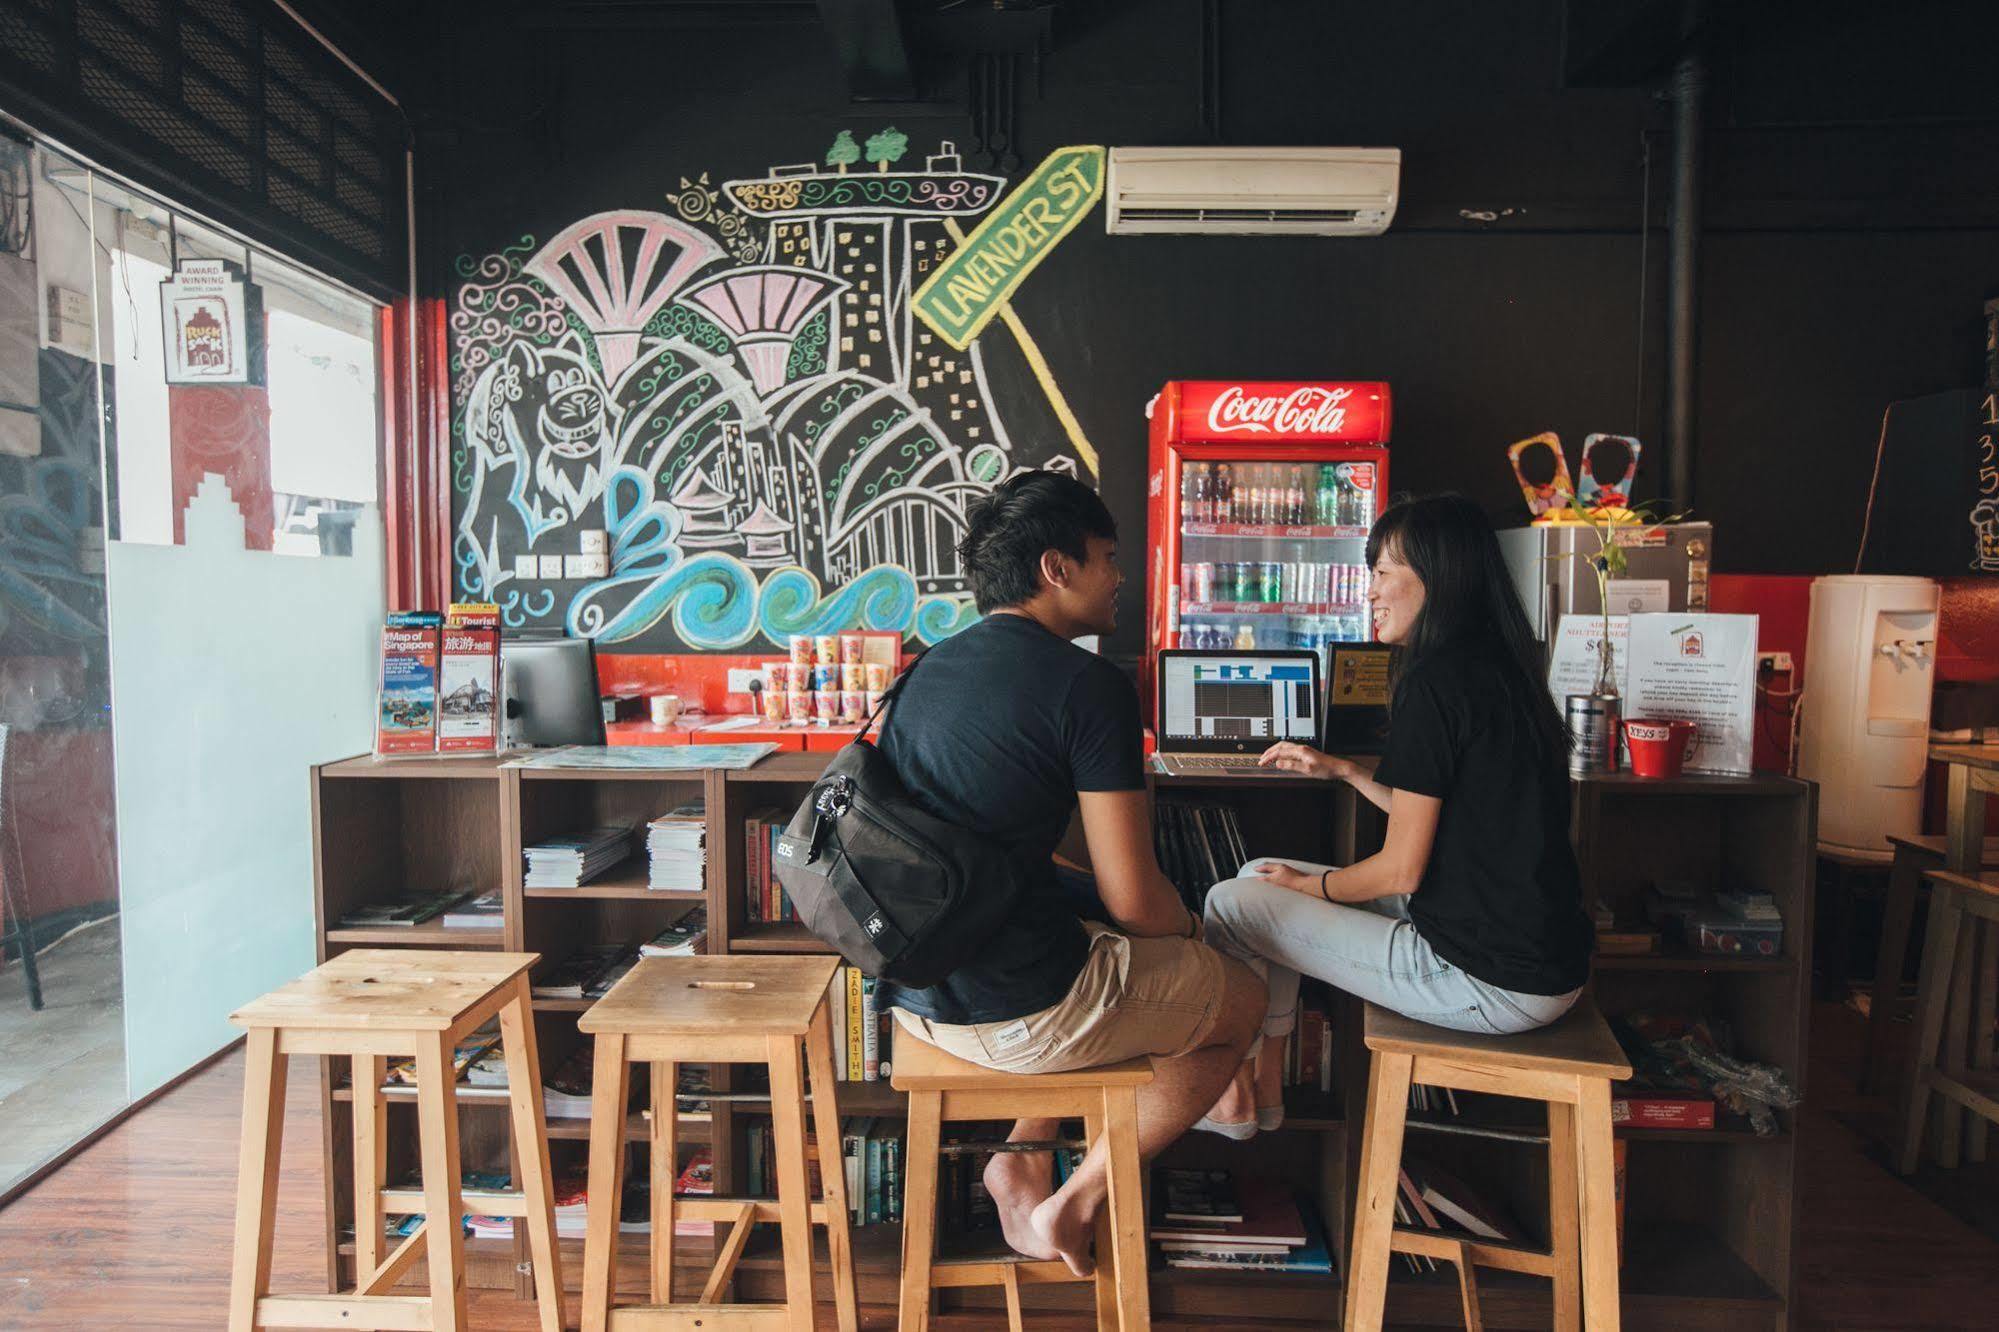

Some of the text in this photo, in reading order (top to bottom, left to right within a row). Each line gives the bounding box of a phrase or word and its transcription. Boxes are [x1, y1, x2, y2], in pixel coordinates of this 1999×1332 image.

[931, 156, 1093, 328] LAVENDER ST
[186, 267, 219, 275] AWARD
[181, 277, 224, 285] WINNING
[187, 326, 220, 340] RUCK
[188, 335, 223, 351] SACK
[1208, 386, 1353, 434] Coca-Cola
[462, 616, 496, 626] Tourist
[385, 642, 434, 652] Singapore
[851, 970, 860, 1070] ZADIE SMITH
